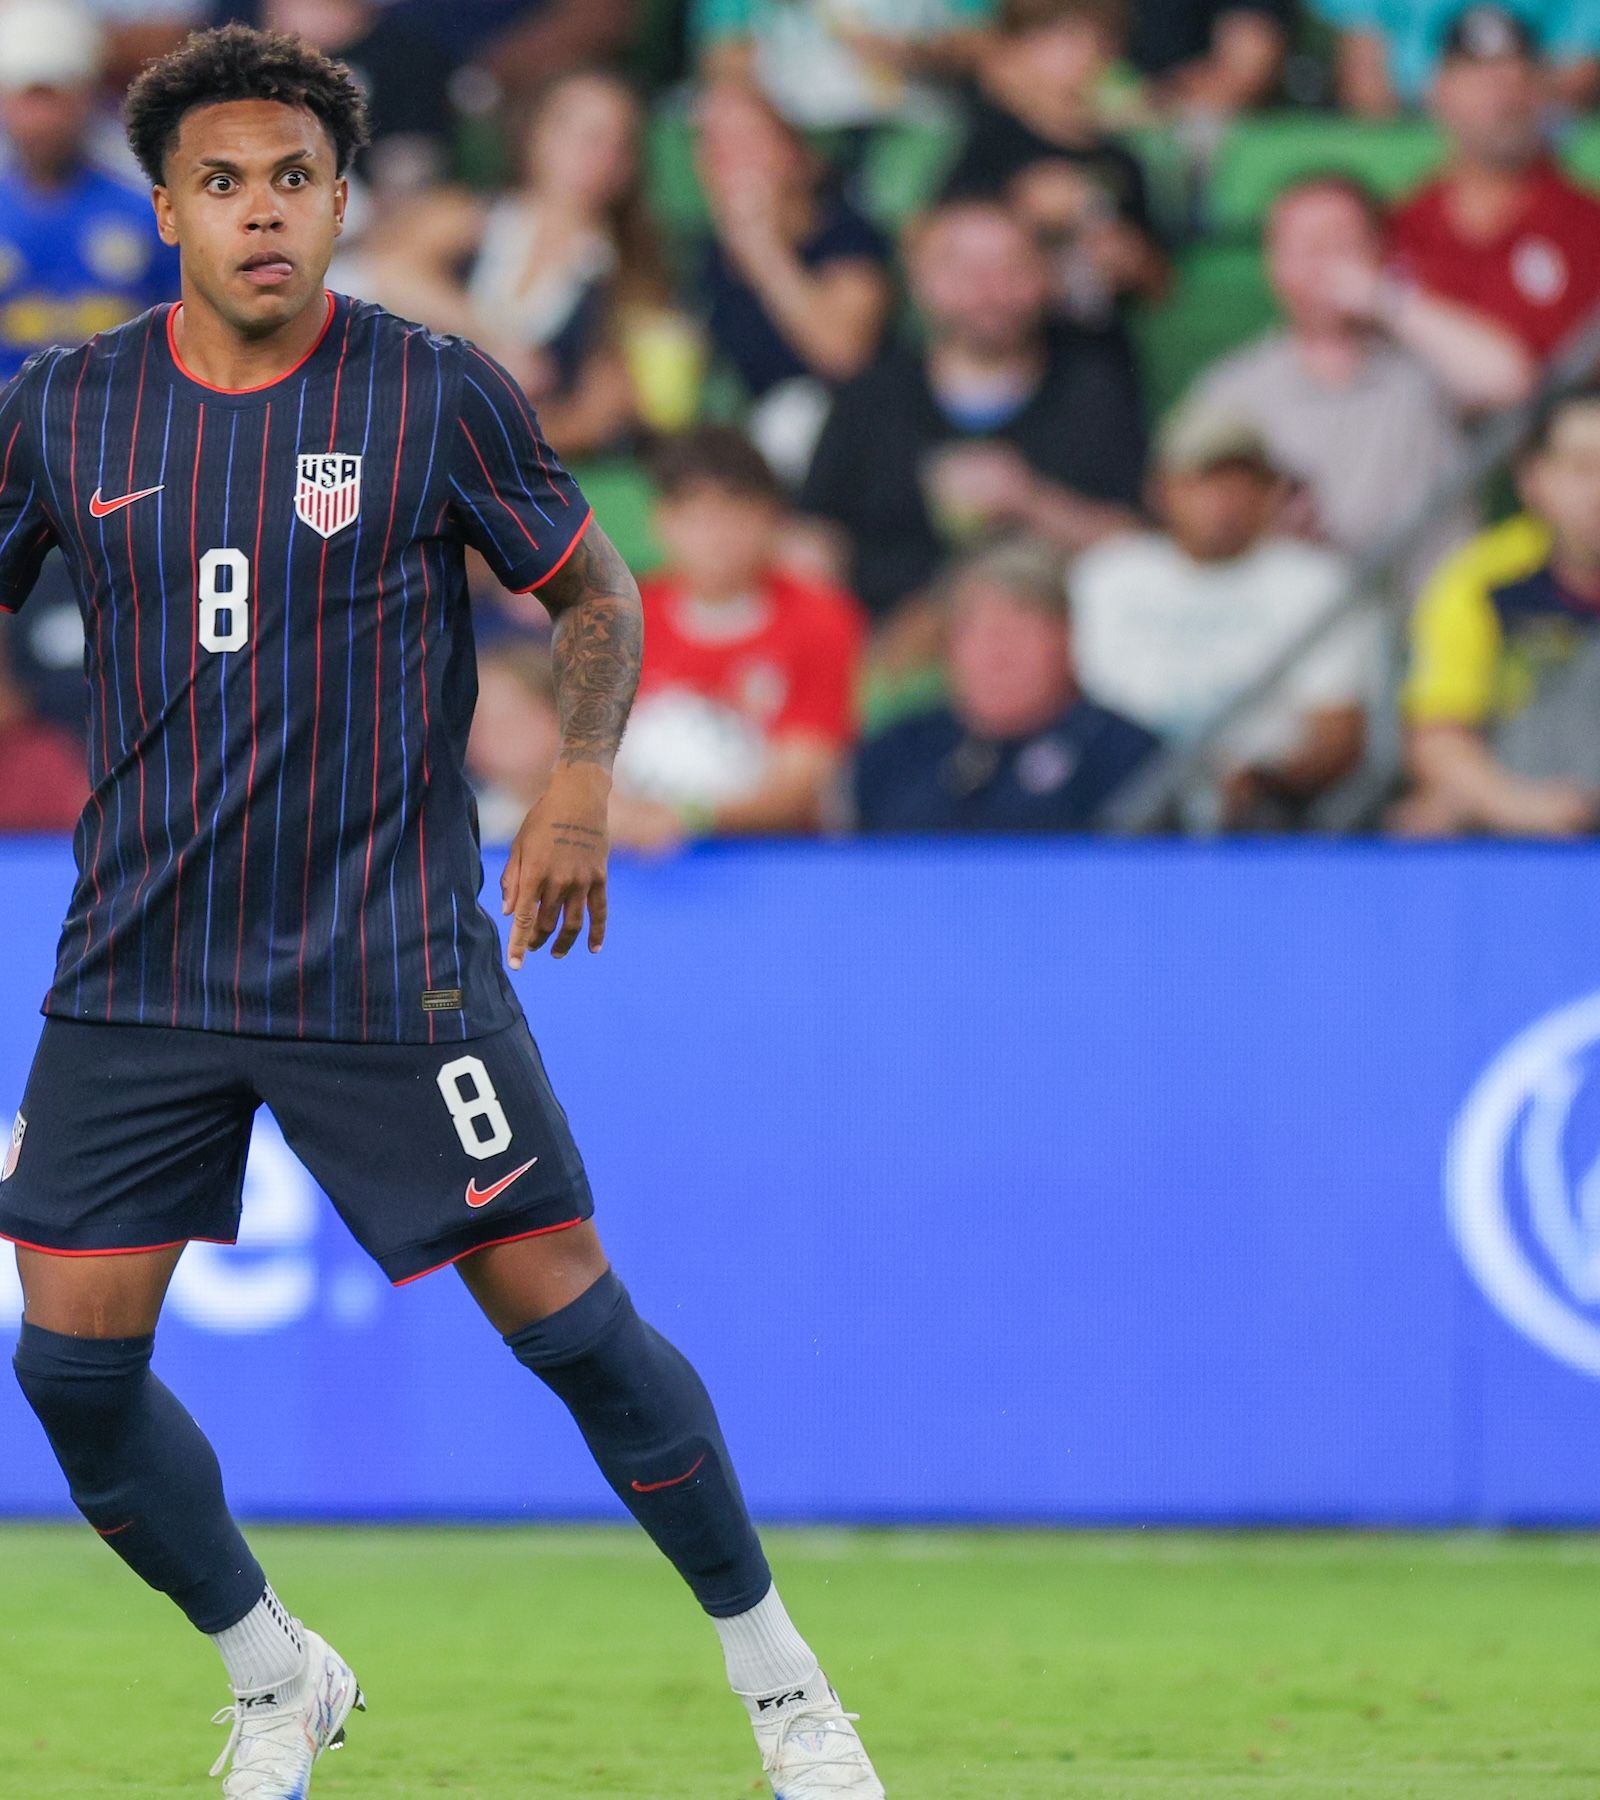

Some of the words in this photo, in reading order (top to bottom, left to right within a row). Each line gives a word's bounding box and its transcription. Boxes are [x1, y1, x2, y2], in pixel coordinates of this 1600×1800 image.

[301, 458, 356, 489] USA
[199, 548, 249, 653] 8
[436, 1055, 513, 1161] 8
